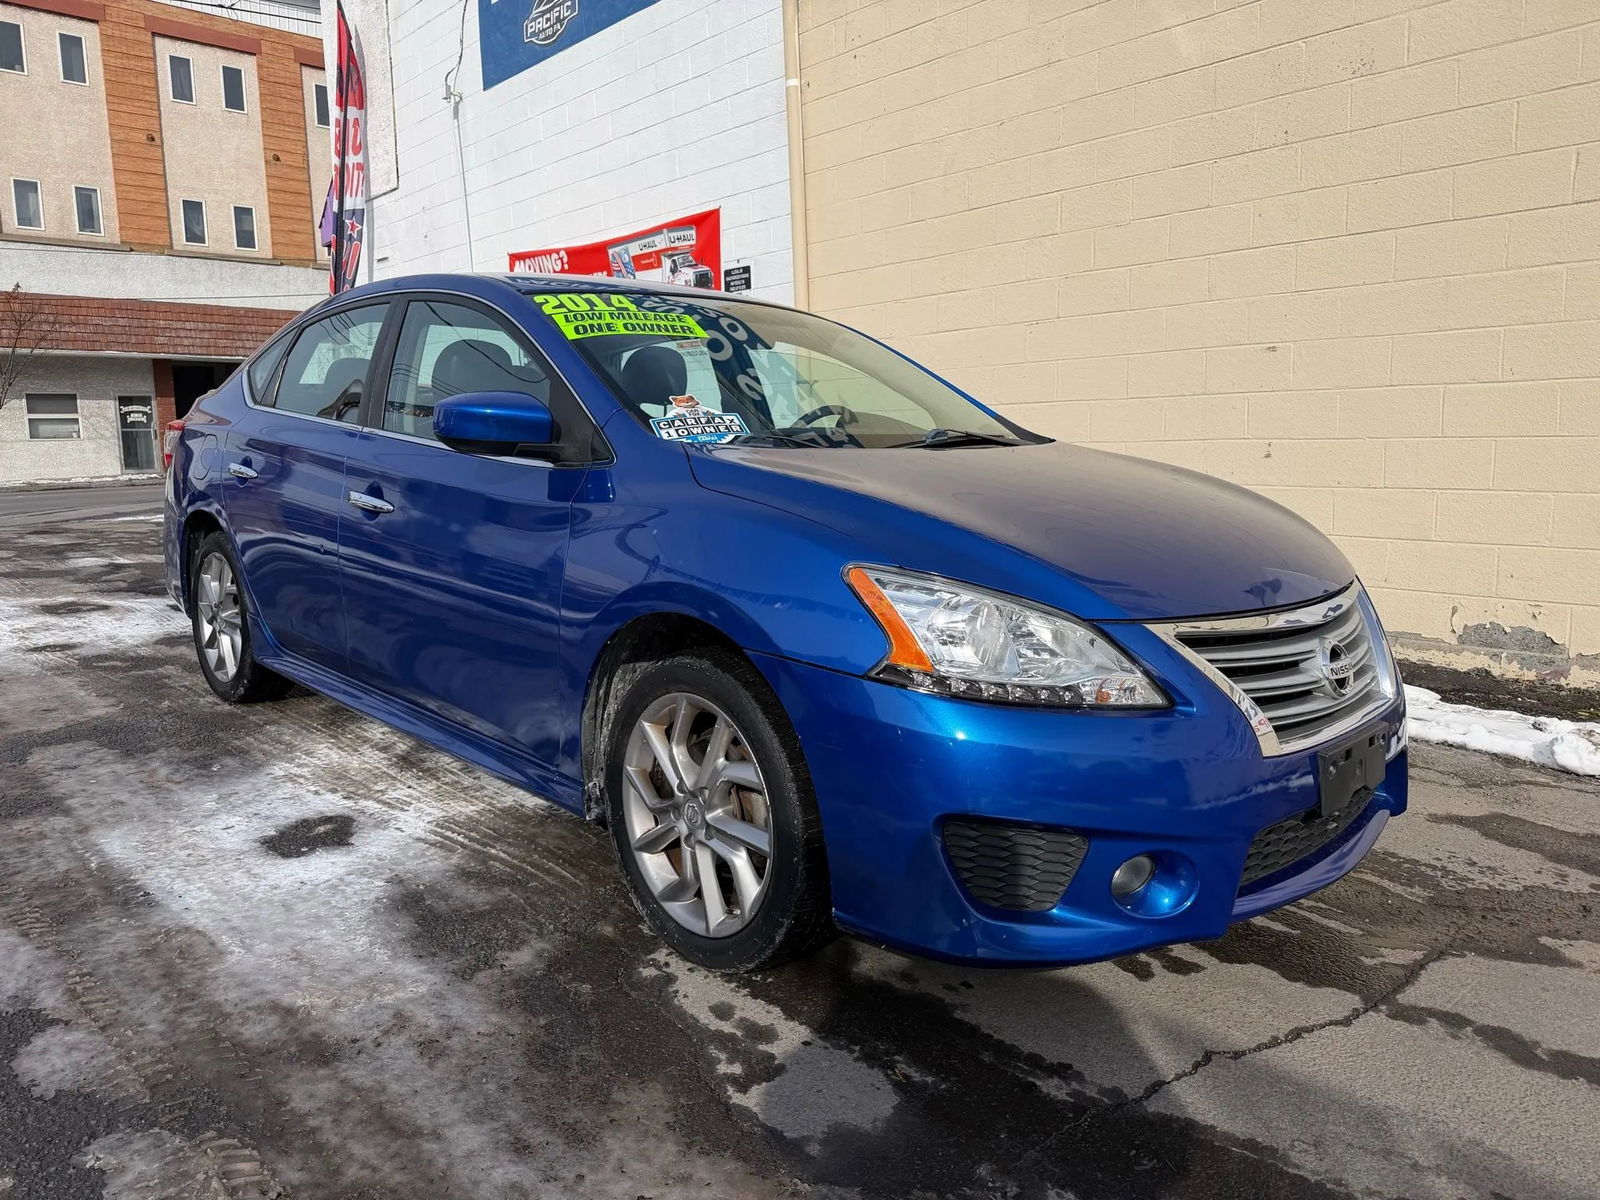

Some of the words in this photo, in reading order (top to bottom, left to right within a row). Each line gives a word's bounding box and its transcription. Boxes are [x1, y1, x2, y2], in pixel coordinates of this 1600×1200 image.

[527, 1, 572, 37] PACIFIC
[514, 250, 568, 273] MOVING?
[534, 293, 638, 314] 2014
[563, 313, 606, 323] LOW
[608, 312, 690, 324] MILEAGE
[573, 322, 618, 336] ONE
[624, 322, 696, 336] OWNER
[659, 416, 736, 428] CARFAX
[679, 424, 742, 437] OWNER
